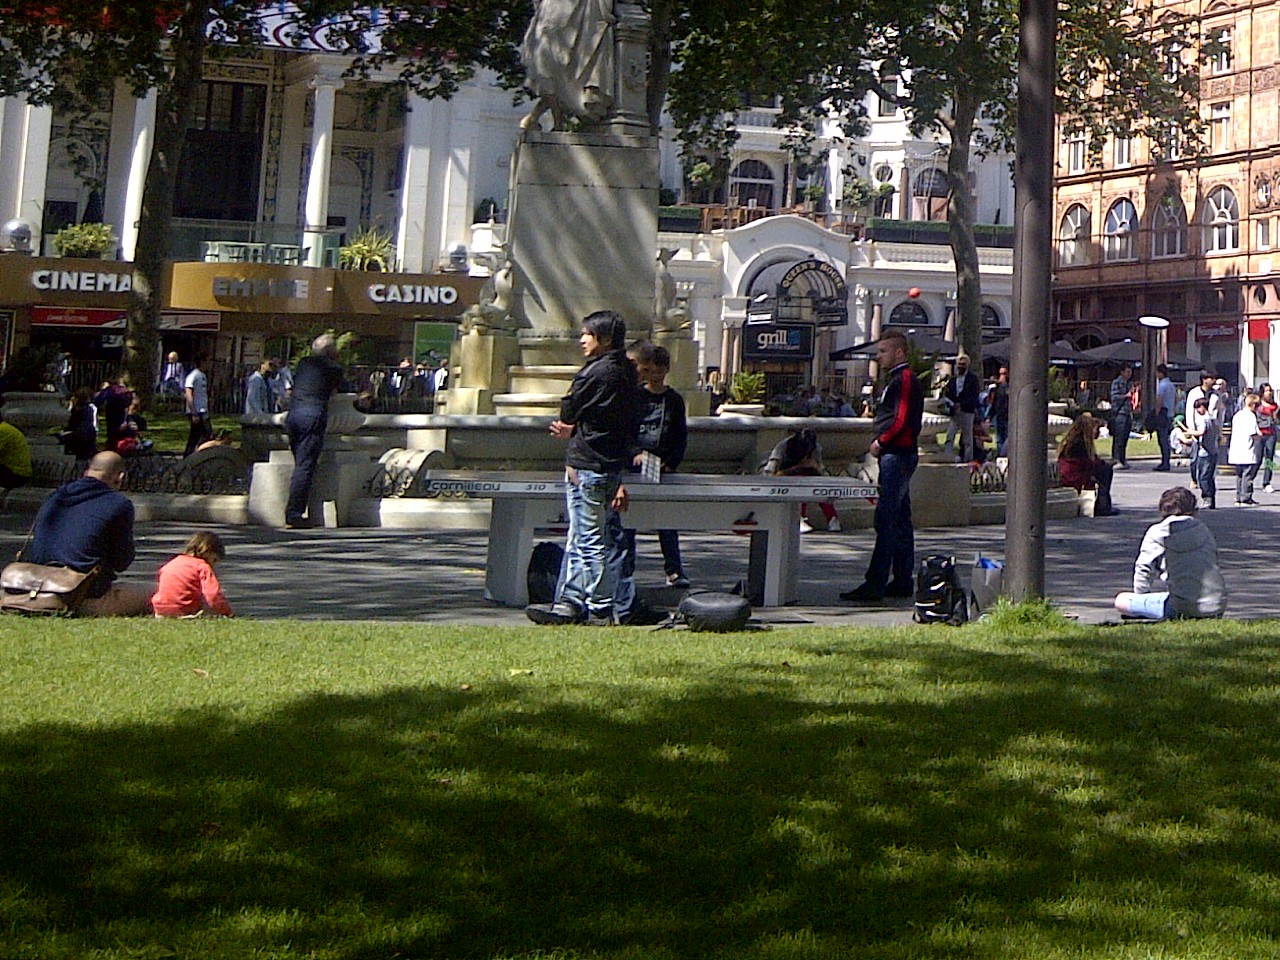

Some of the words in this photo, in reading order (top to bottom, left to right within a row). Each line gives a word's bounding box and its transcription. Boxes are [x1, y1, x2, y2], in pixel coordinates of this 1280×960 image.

[32, 269, 133, 293] CINEMA
[213, 276, 309, 299] EMPIRE
[368, 283, 459, 305] CASINO
[757, 330, 788, 349] grill
[431, 481, 501, 491] cornilleau
